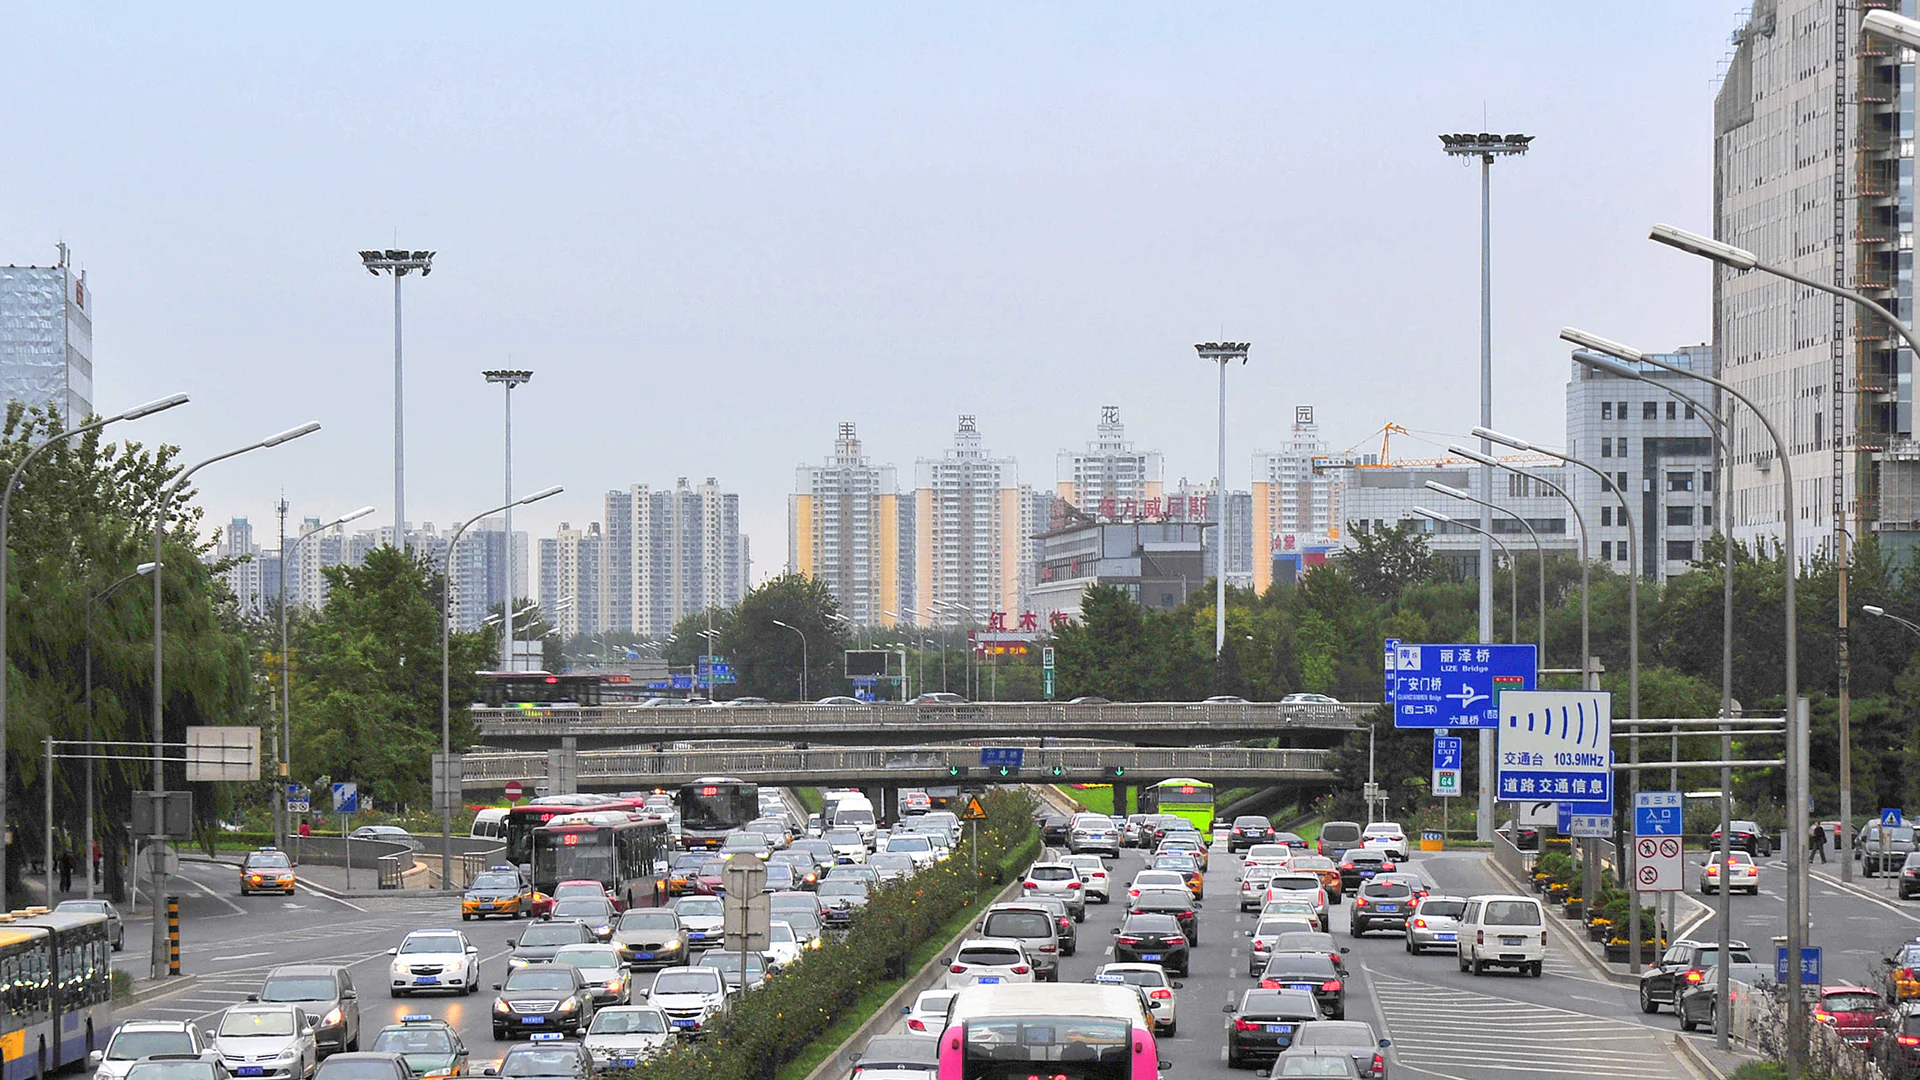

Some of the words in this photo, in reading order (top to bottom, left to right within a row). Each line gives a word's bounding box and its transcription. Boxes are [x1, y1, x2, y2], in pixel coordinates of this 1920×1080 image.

[1101, 406, 1119, 424] 花
[1296, 406, 1313, 424] 园
[839, 422, 856, 439] 丰
[958, 415, 976, 432] 益
[1440, 649, 1490, 663] 丽泽桥
[1462, 665, 1489, 673] Bridge
[1397, 677, 1442, 691] 广安门桥
[1449, 715, 1479, 725] 六里桥
[1438, 740, 1457, 748] 出口
[1503, 752, 1543, 766] 交通台
[1554, 753, 1604, 767] 103.9MHz
[1441, 777, 1452, 786] G4
[1503, 778, 1603, 794] 道路交通信息
[1641, 796, 1677, 805] 西三环
[1646, 809, 1671, 819] 入口
[1779, 957, 1818, 974] 应车道
